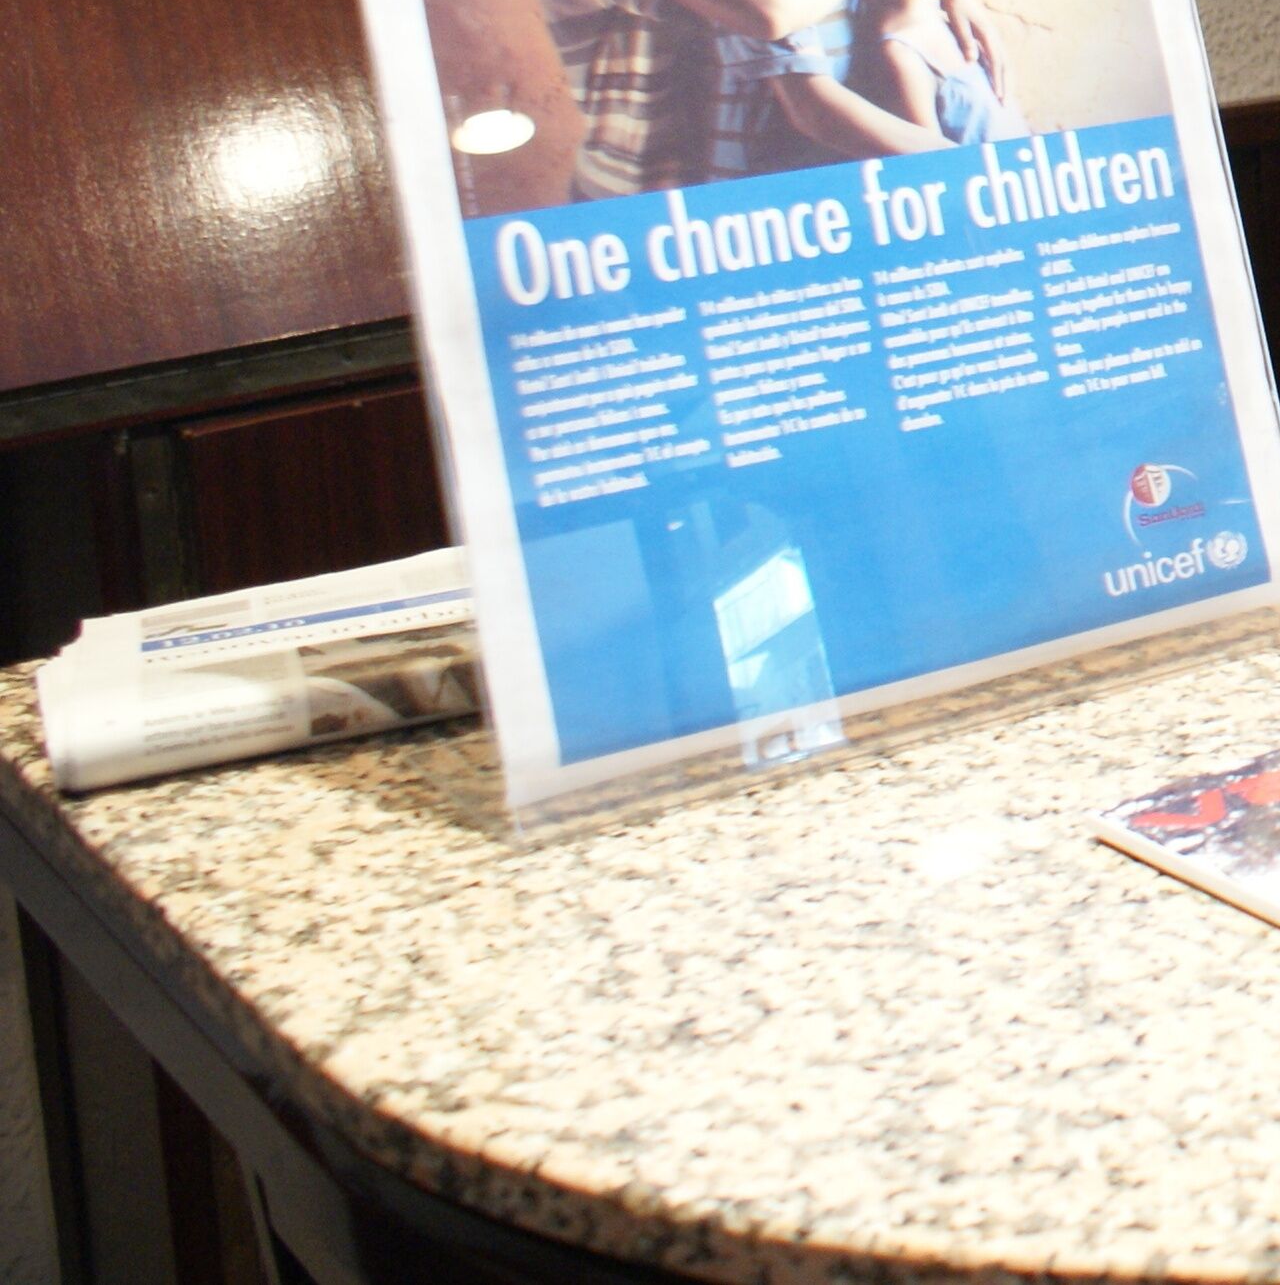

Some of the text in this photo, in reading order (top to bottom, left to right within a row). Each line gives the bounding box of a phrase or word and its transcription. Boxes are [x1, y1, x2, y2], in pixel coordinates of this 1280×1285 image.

[496, 127, 1174, 305] One chance for children
[1104, 537, 1204, 597] unicef
